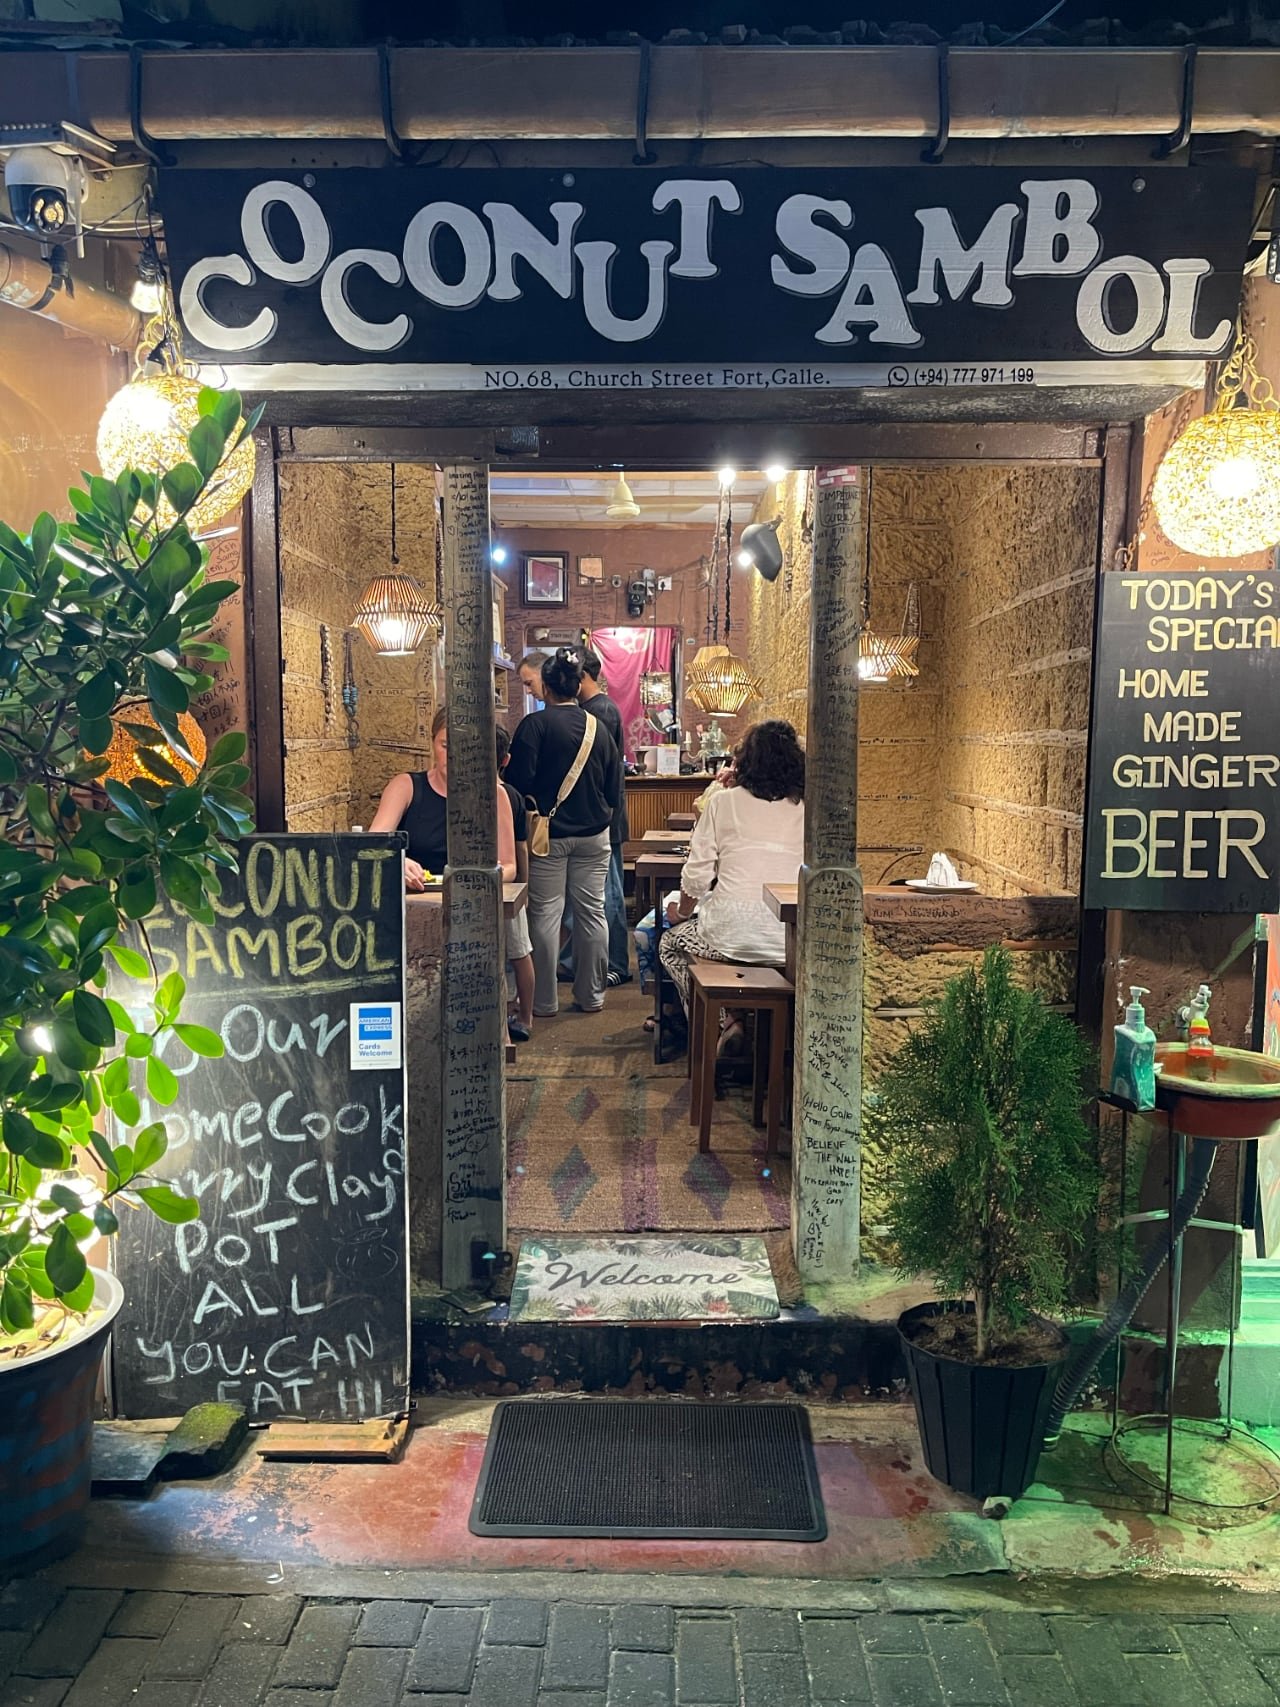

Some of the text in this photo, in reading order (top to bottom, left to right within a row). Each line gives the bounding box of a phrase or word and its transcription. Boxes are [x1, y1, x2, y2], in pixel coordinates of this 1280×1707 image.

[180, 179, 1233, 354] COCONUT SAMBOL
[485, 371, 559, 389] NO.68,
[568, 369, 643, 387] Church
[651, 369, 713, 387] Street
[914, 368, 949, 386] (+94)
[953, 368, 977, 383] 777
[981, 368, 1005, 383] 971
[1011, 367, 1034, 383] 199
[1122, 575, 1274, 610] TODAY'S
[1118, 669, 1209, 698] HOME
[1143, 711, 1242, 742] MADE
[1112, 754, 1280, 788] GINGER
[1101, 809, 1270, 880] BEER
[137, 914, 398, 984] SAMBOL
[114, 1162, 272, 1217] urry
[545, 1262, 742, 1291] Welcome
[193, 1274, 324, 1324] ALL
[263, 1321, 375, 1378] CAN
